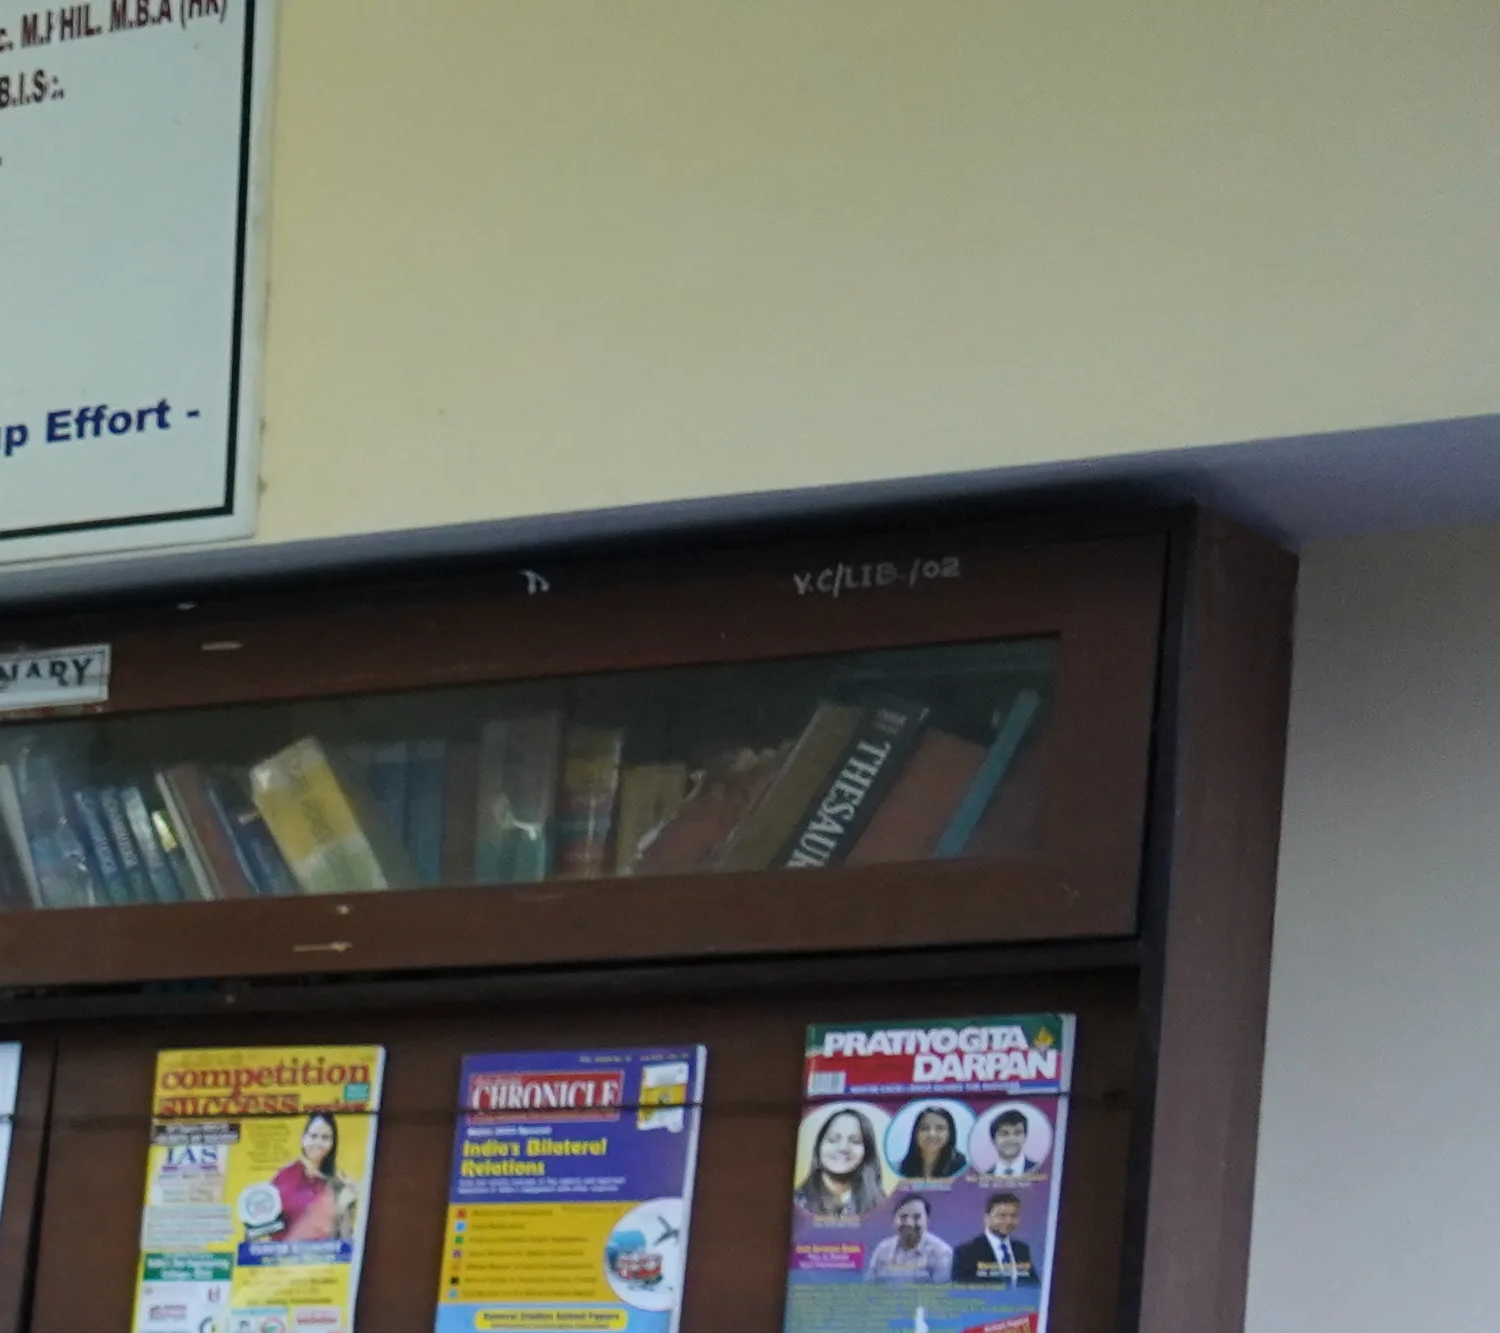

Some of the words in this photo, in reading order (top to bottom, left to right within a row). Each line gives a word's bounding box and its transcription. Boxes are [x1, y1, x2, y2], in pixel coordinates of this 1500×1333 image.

[45, 399, 170, 443] Effort
[823, 1024, 1029, 1057] PRATIYOGITA
[161, 1056, 371, 1095] competition
[913, 1049, 1057, 1082] DARPAN
[472, 1079, 618, 1109] CHRONICLE
[463, 1139, 520, 1157] India's
[526, 1137, 608, 1156] Bilateral
[461, 1159, 545, 1177] Relations
